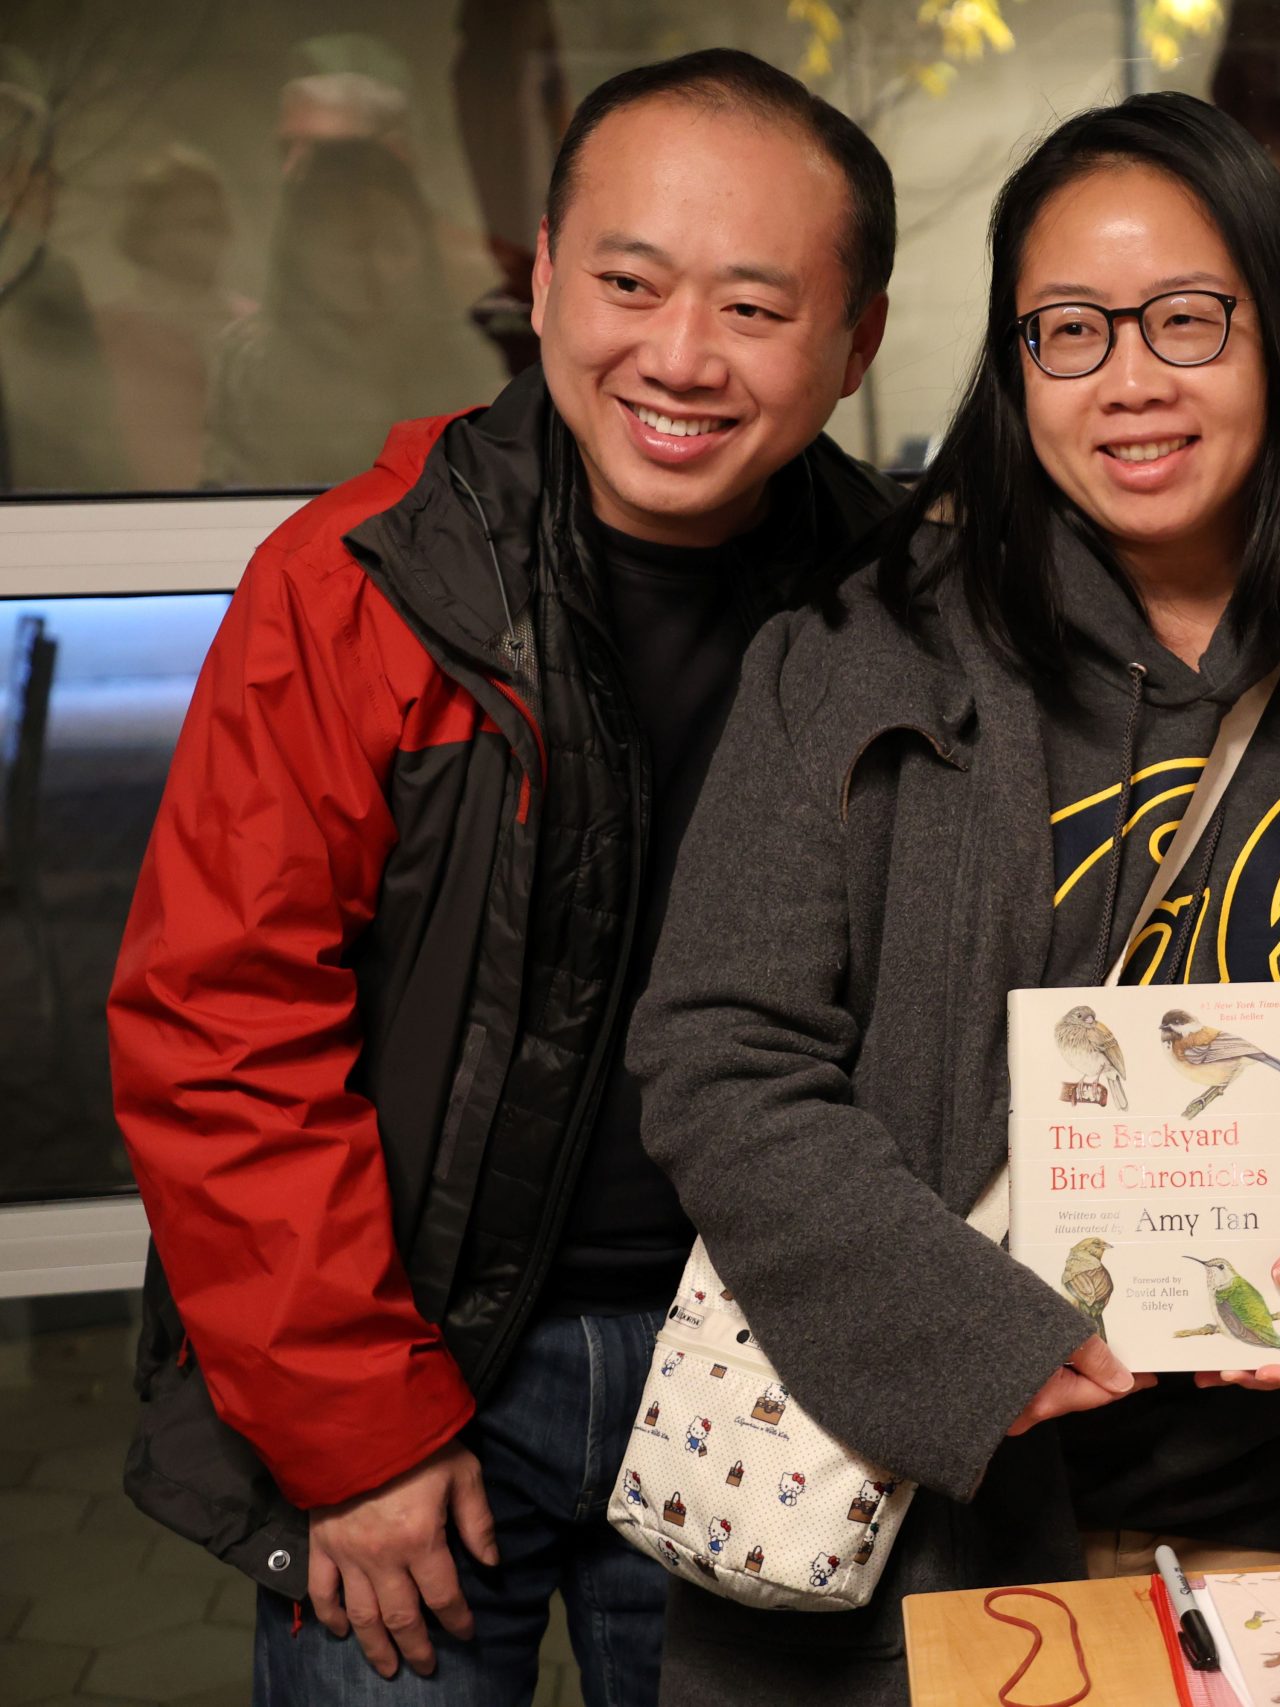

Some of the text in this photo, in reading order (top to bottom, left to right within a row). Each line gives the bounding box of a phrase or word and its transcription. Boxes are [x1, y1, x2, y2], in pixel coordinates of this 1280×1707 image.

[1215, 1001, 1233, 1009] New
[1236, 1001, 1255, 1009] York
[1220, 1012, 1265, 1021] Best Seller
[1049, 1122, 1240, 1152] The Backyard
[1050, 1162, 1269, 1191] Bird Chronicles
[1058, 1209, 1121, 1221] Written and
[1136, 1206, 1260, 1236] Amy Tan
[1055, 1223, 1109, 1234] illustrated
[1133, 1276, 1182, 1285] Foreword by
[1126, 1287, 1189, 1298] David Allen
[1141, 1301, 1174, 1312] Sibley
